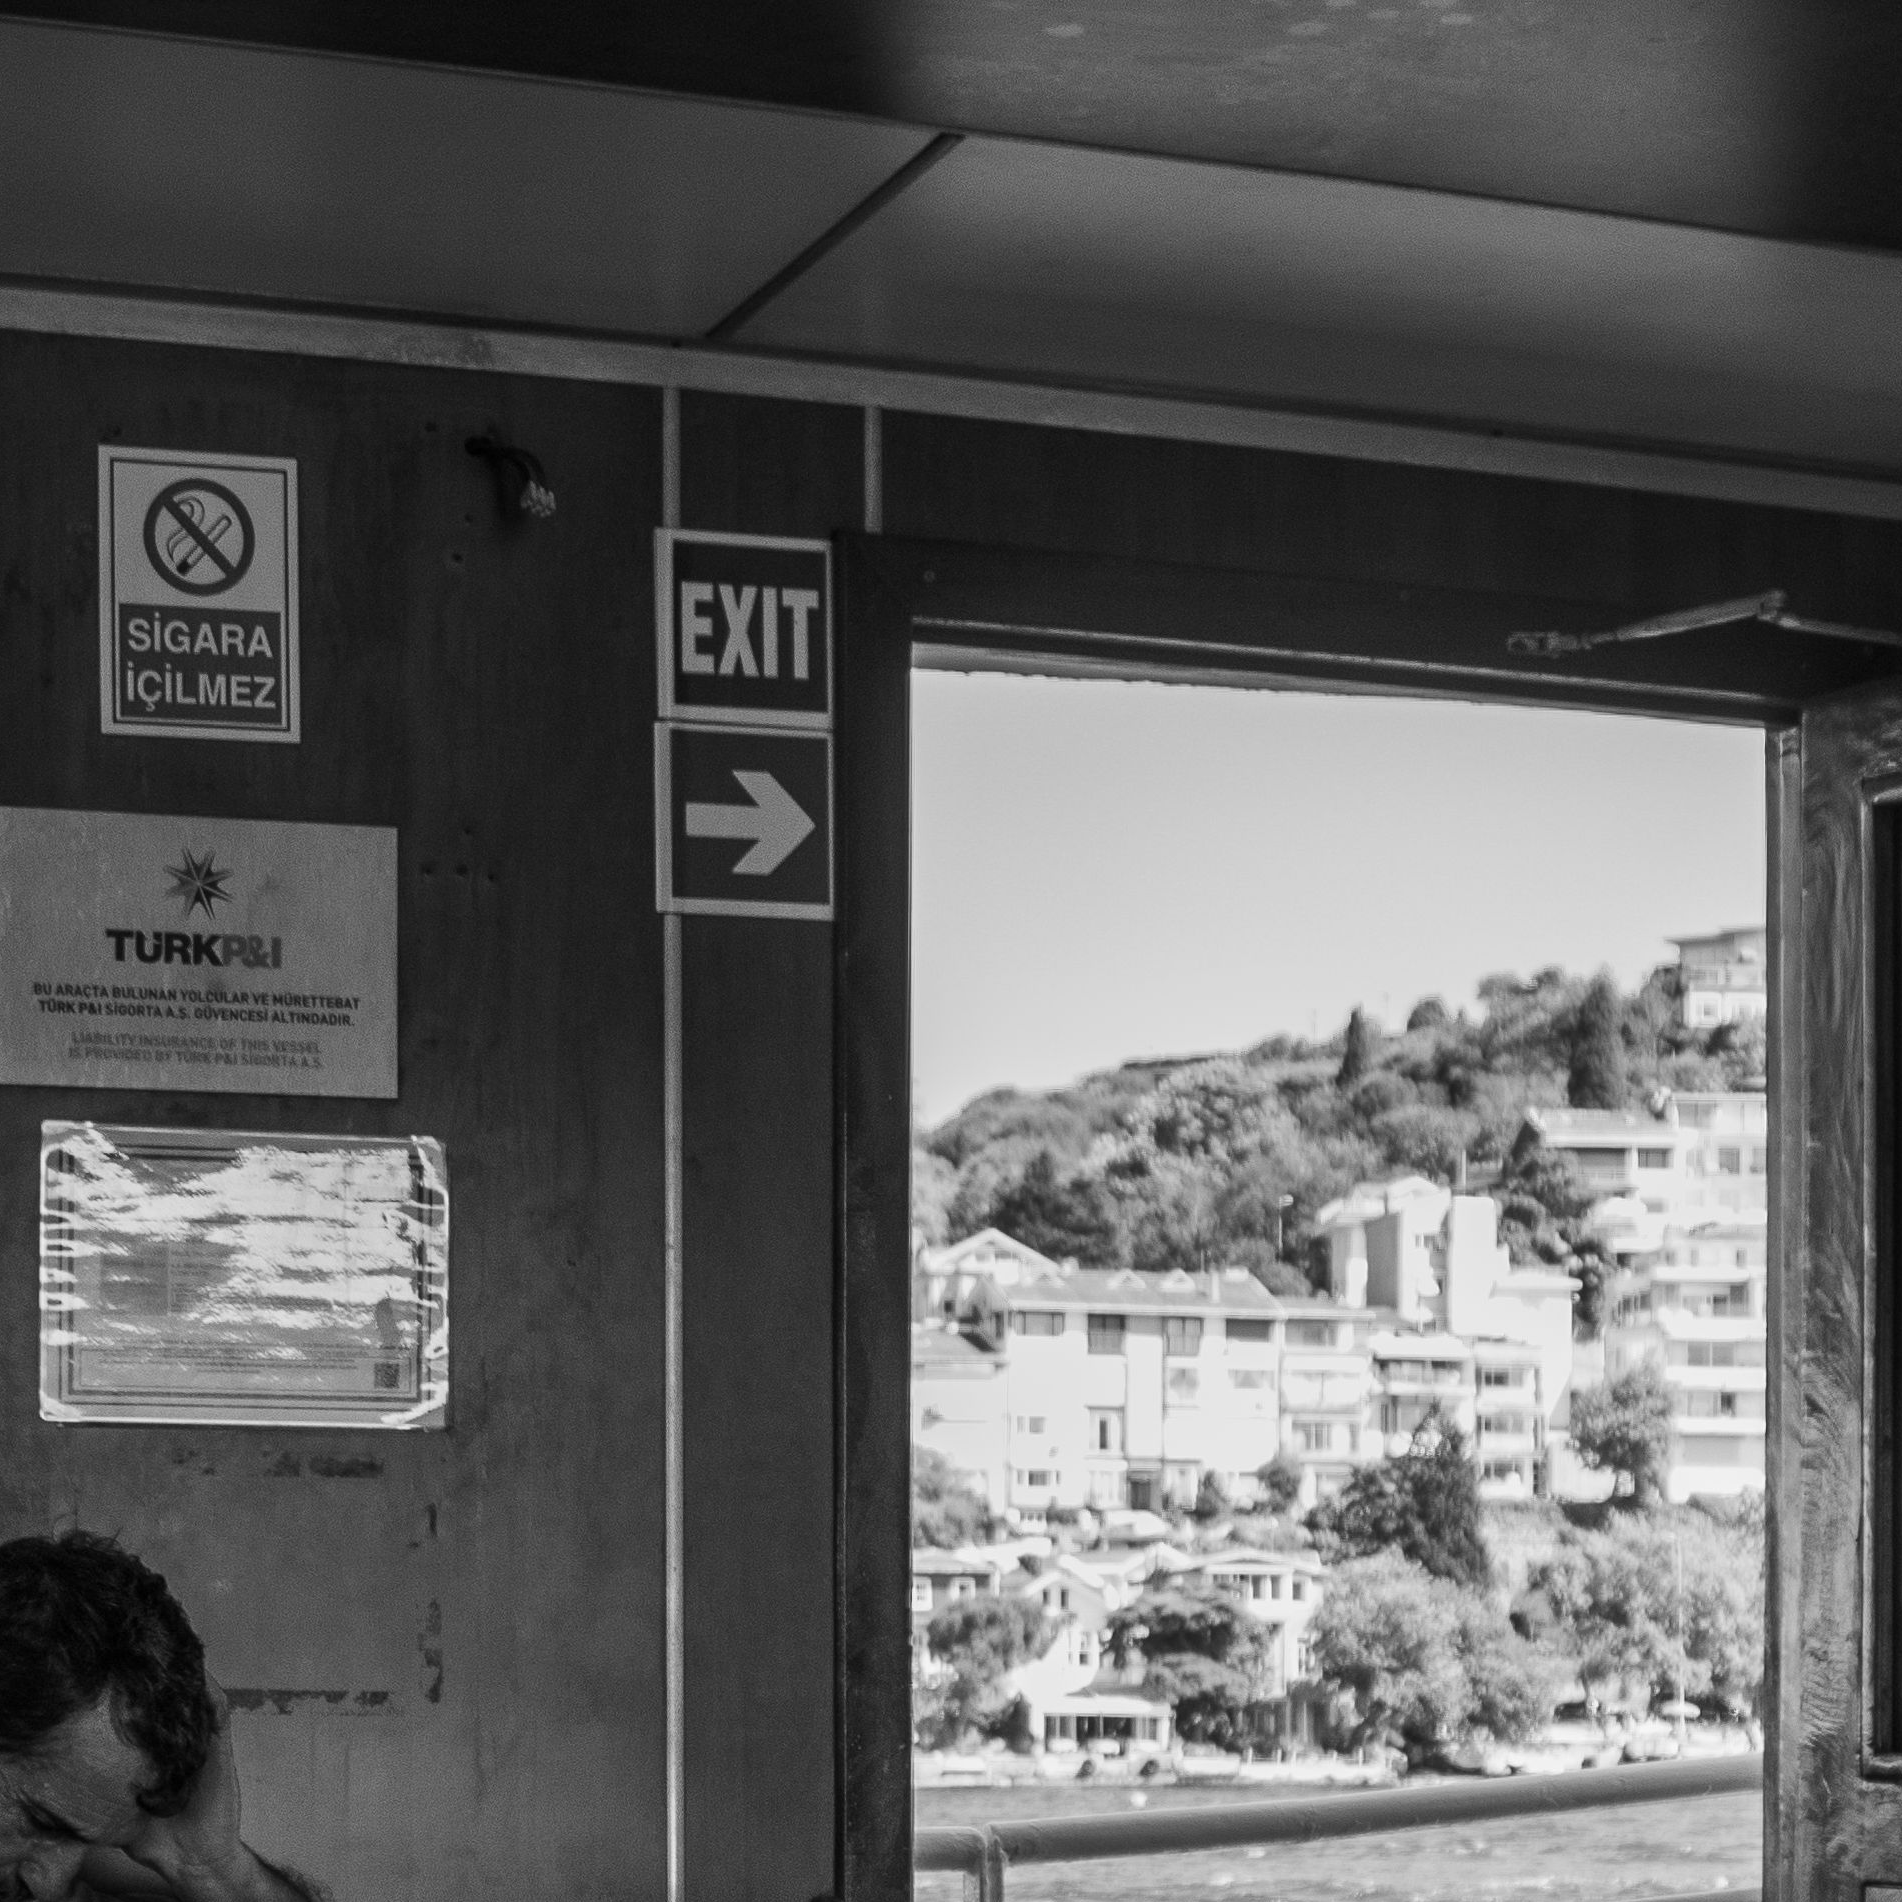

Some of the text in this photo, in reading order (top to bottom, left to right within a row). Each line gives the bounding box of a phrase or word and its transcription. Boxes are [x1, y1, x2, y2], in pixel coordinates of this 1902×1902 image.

[128, 612, 272, 658] SİGARA
[682, 582, 818, 679] EXIT
[127, 661, 275, 710] İÇİLMEZ
